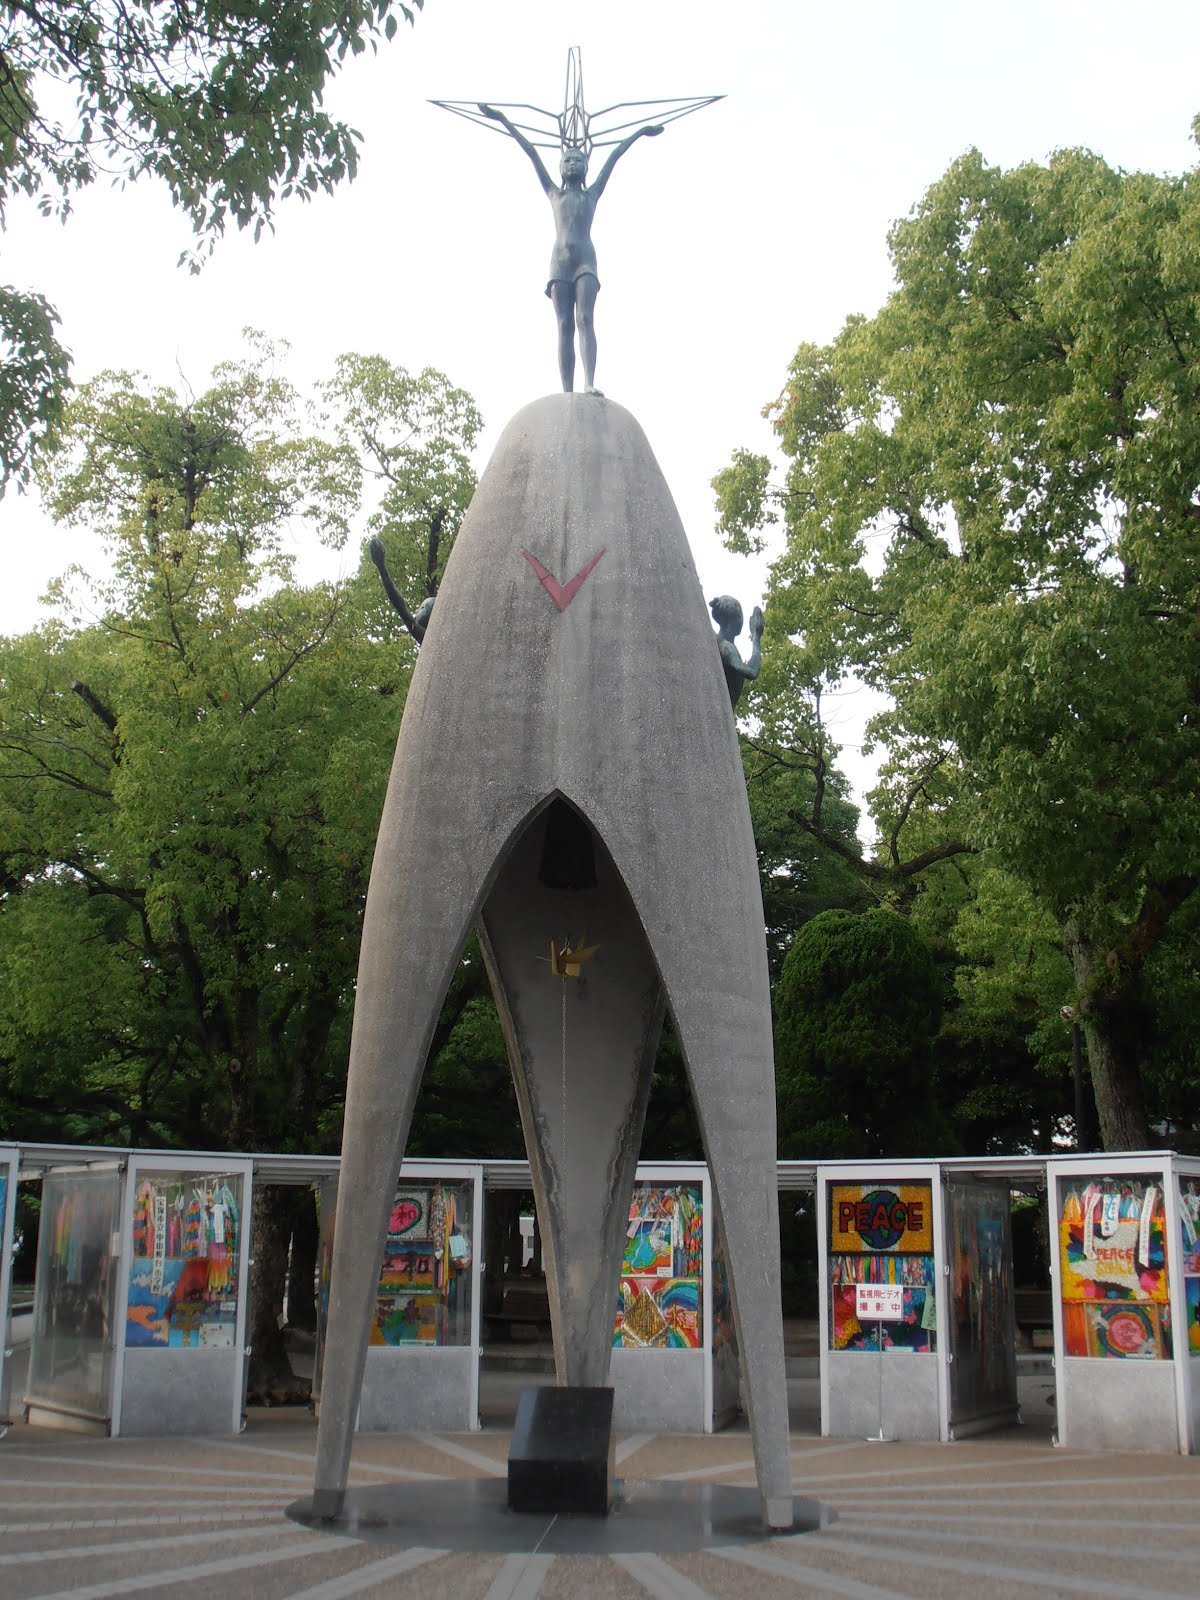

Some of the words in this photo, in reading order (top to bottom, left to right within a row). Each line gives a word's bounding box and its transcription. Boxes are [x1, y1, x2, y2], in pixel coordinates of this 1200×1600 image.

[391, 1204, 417, 1225] 和
[839, 1201, 923, 1233] PEACE
[1096, 1248, 1132, 1260] PEACE
[859, 1289, 901, 1299] 監視用ビデオ
